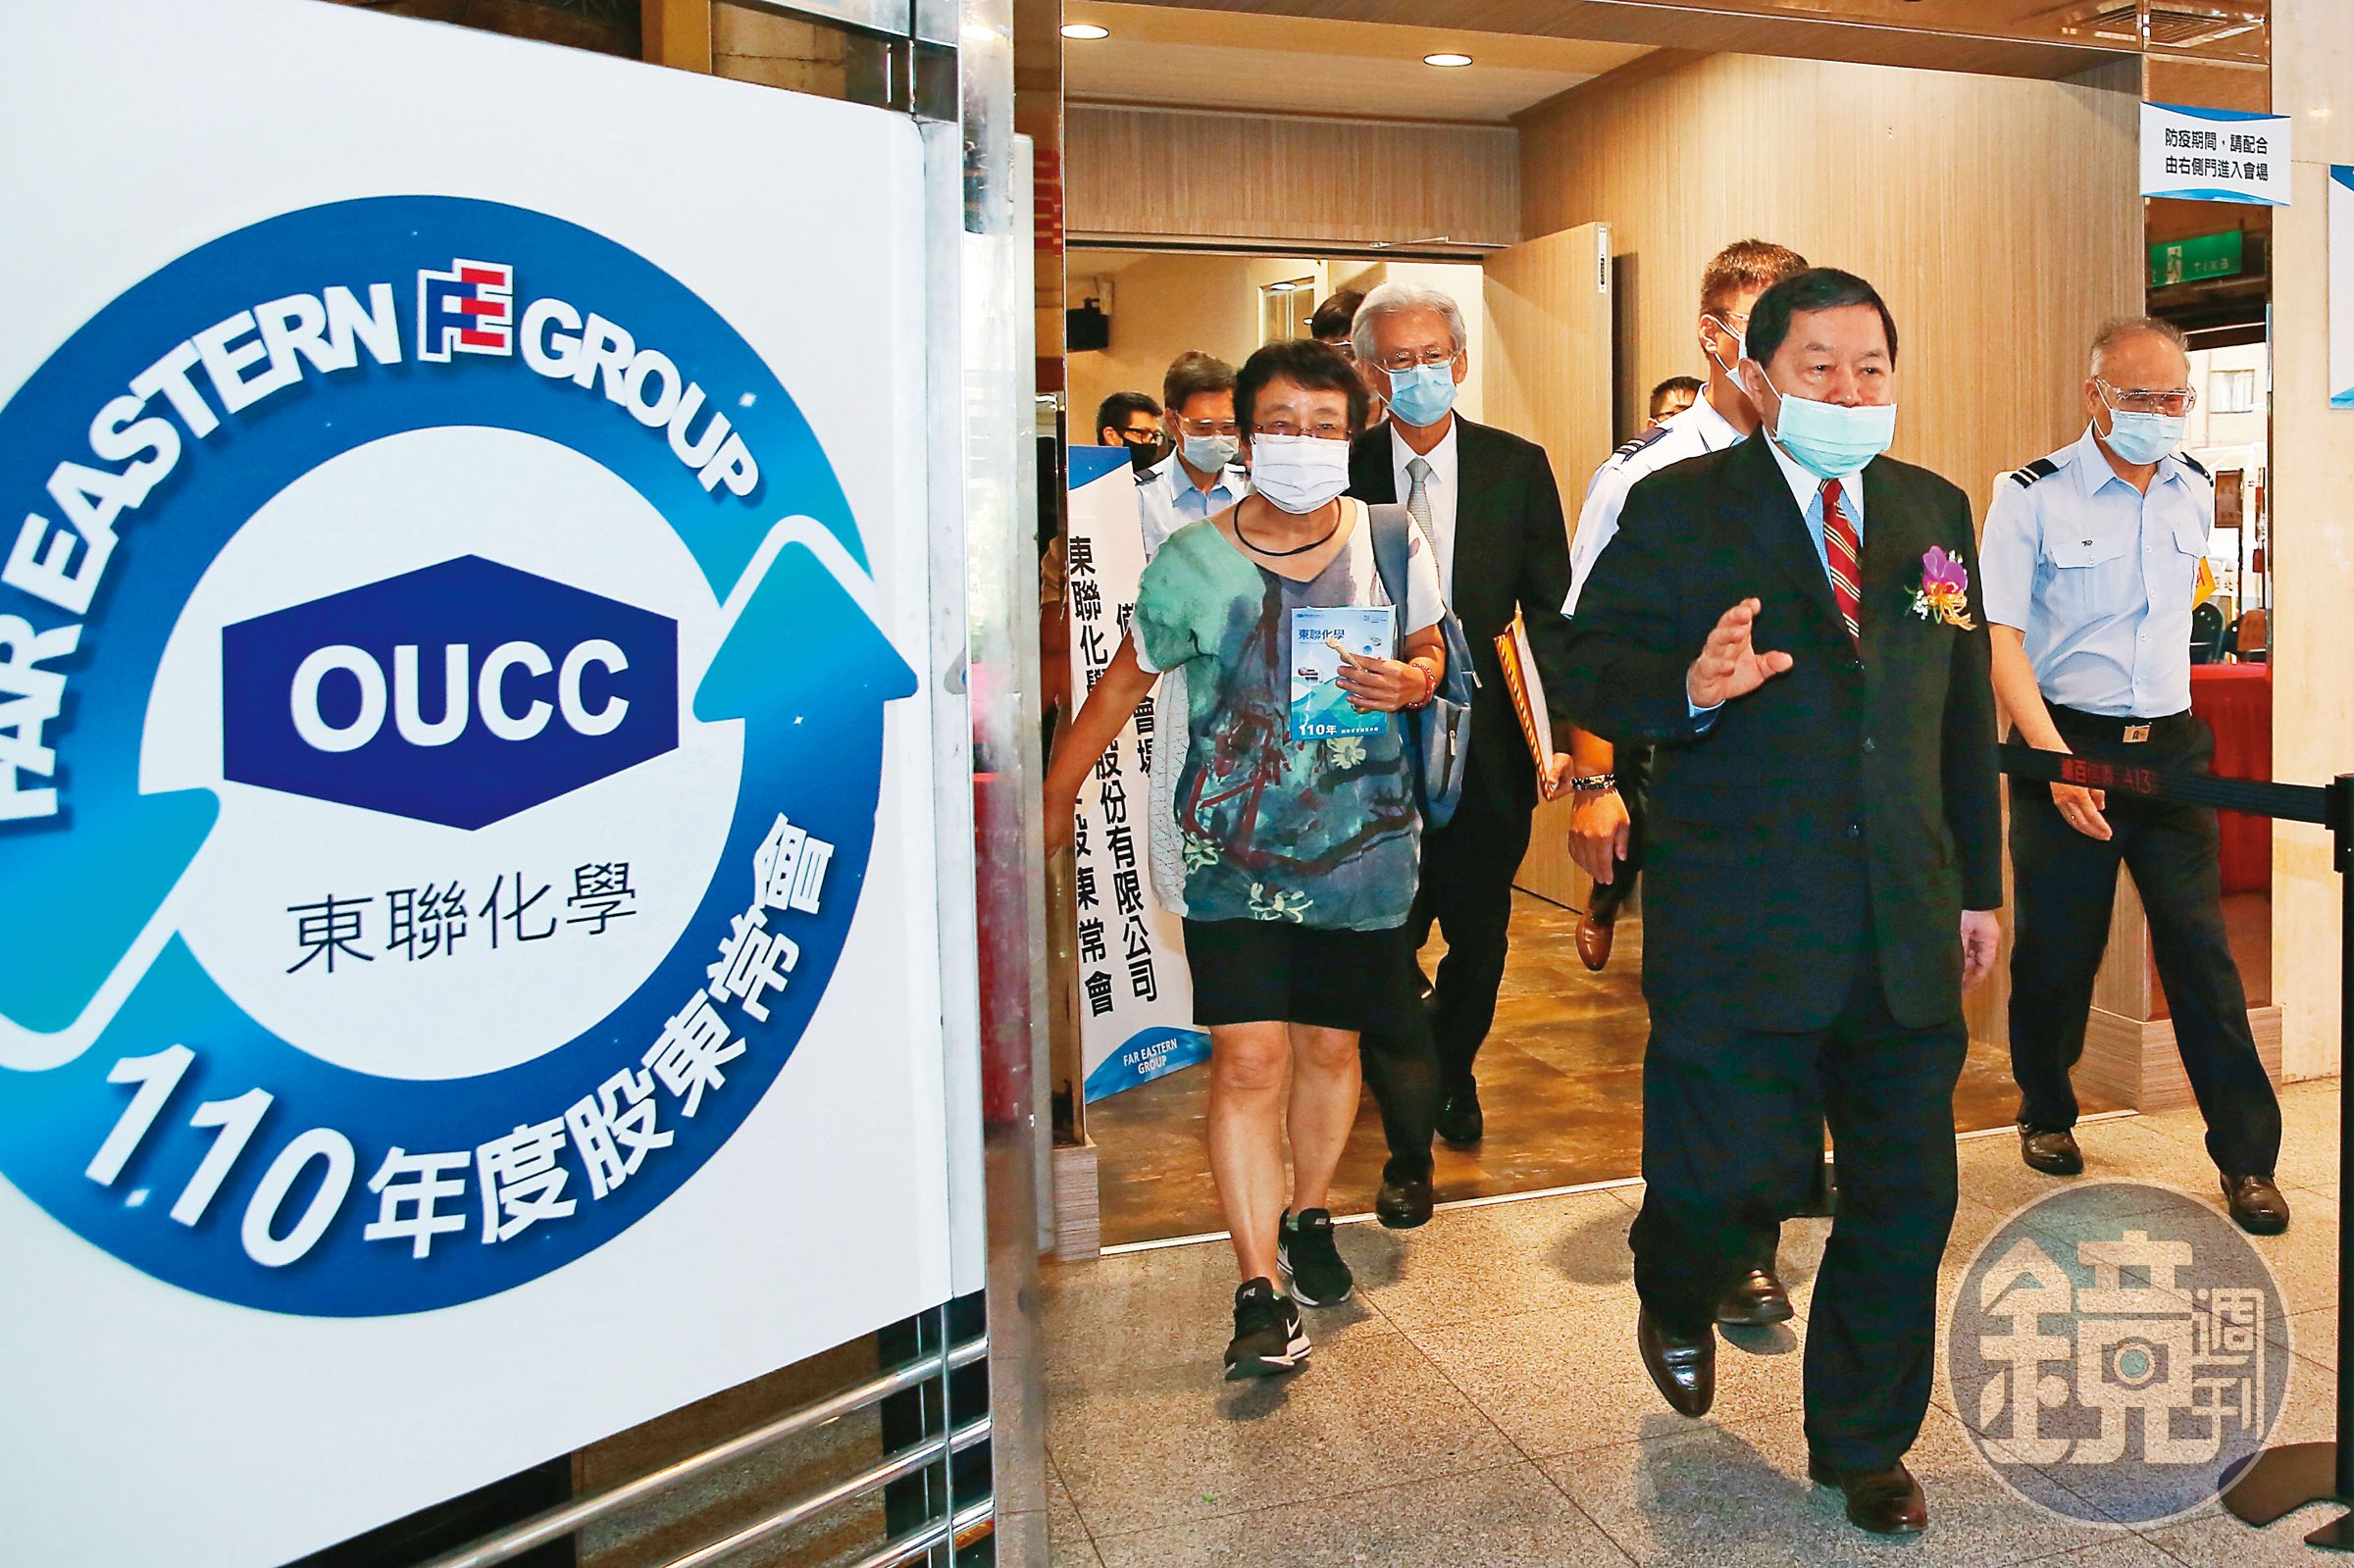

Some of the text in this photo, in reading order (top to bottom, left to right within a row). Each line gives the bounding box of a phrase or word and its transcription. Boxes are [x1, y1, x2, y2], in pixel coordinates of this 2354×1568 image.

[2165, 154, 2269, 181] 由右側門進入會場
[2, 282, 402, 615] EASTERN
[520, 297, 760, 498] GROUP
[1299, 629, 1345, 640] 東聯化學
[290, 638, 630, 753] OUCC
[1299, 724, 1337, 735] 110年
[284, 861, 638, 975] 東聯化學
[84, 812, 837, 1268] 110年度股東常會
[1123, 1037, 1177, 1067] FAR EASTERN
[1138, 1055, 1167, 1075] GROUP
